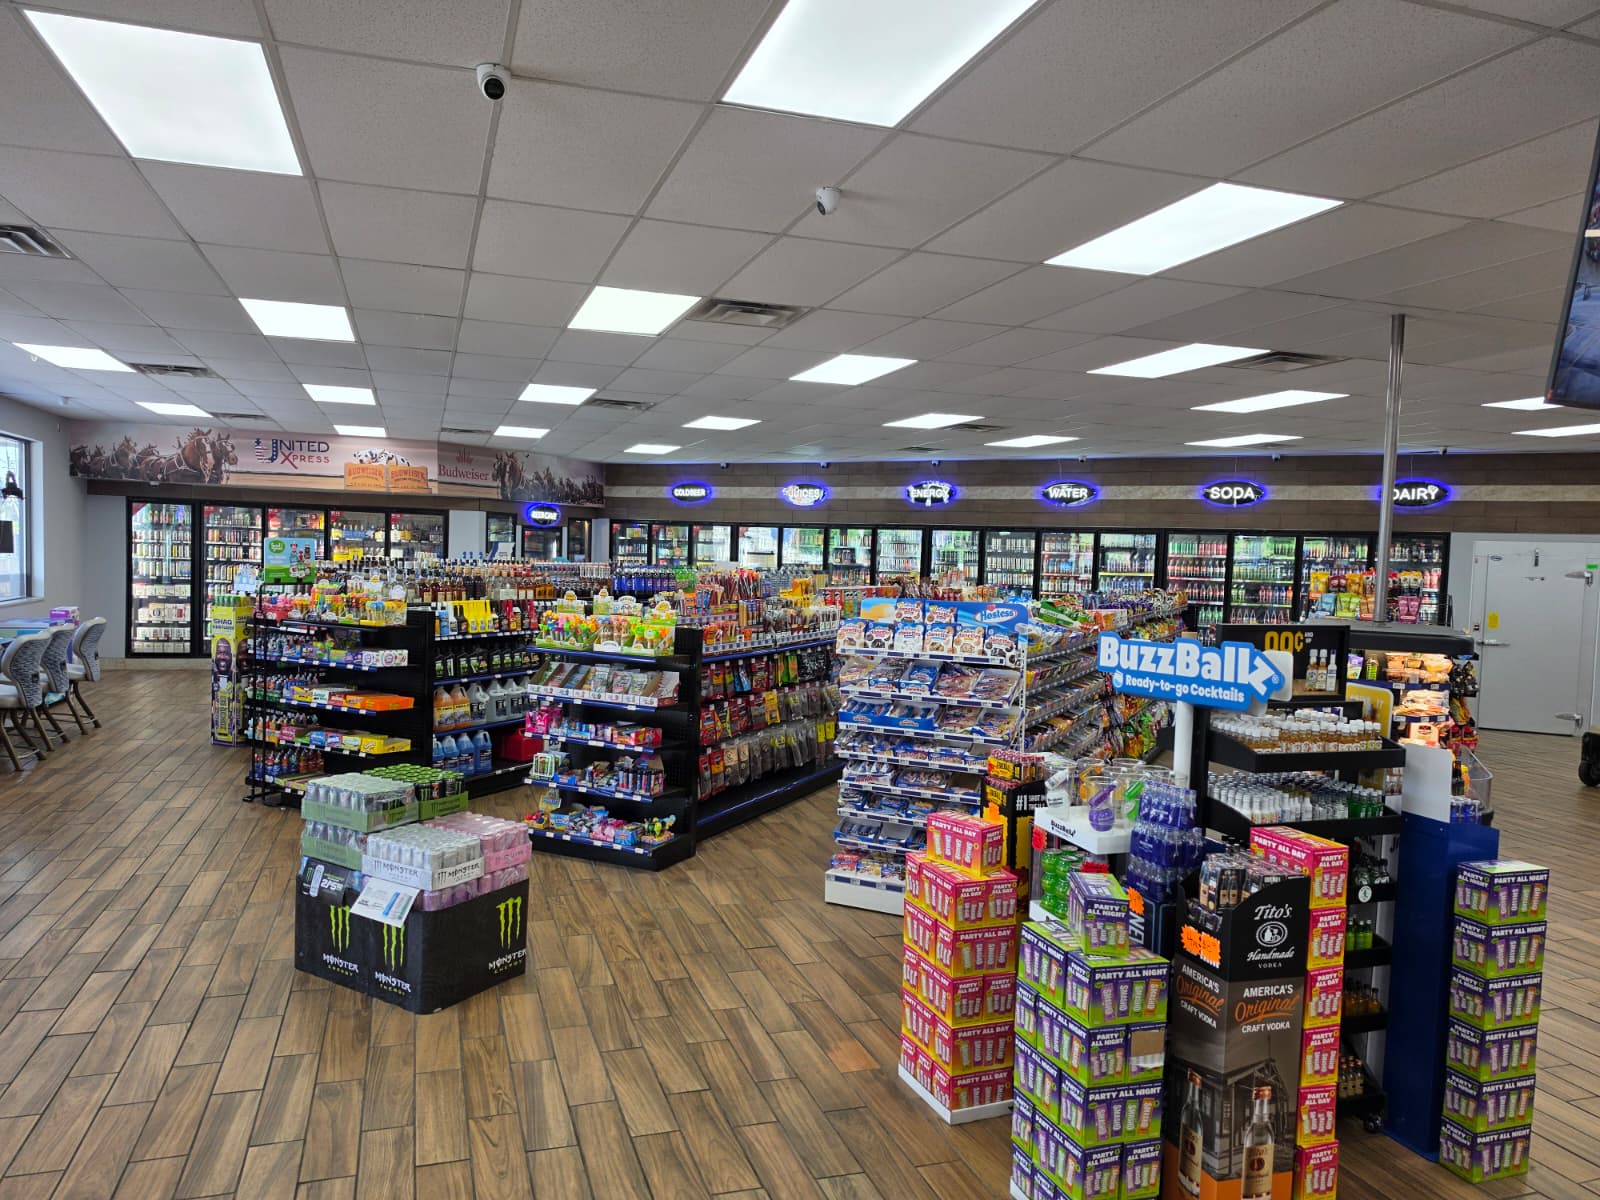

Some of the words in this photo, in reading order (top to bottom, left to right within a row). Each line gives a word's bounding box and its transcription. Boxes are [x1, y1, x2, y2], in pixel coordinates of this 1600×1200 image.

[255, 438, 330, 463] UNITED
[280, 451, 330, 469] XPRESS
[438, 463, 490, 481] Budweiser
[910, 487, 948, 499] ENERGY
[1049, 487, 1087, 499] WATER
[1210, 487, 1255, 499] SODA
[980, 607, 1014, 622] Hostess
[1125, 676, 1190, 697] Ready-to-go
[1190, 683, 1245, 703] Cocktails
[932, 820, 951, 830] PARTY
[953, 825, 963, 834] ALL
[964, 829, 976, 837] DAY
[1254, 836, 1277, 849] PARTY
[1278, 843, 1290, 853] ALL
[1291, 850, 1306, 859] DAY
[384, 863, 418, 876] MONSTER
[449, 863, 480, 877] MONSTER
[1494, 876, 1515, 884] PARTY
[1102, 910, 1126, 918] NIGHT
[1254, 904, 1292, 920] Tito's
[960, 932, 982, 940] PARTY
[1492, 929, 1513, 937] PARTY
[1247, 947, 1295, 962] Handmade
[323, 953, 359, 973] MONSTER
[1095, 971, 1123, 980] PARTY
[1125, 970, 1141, 978] ALL
[1143, 968, 1168, 976] NIGHT
[1181, 964, 1220, 994] AMERICA'S
[375, 972, 411, 992] MONSTER
[1489, 981, 1510, 989] PARTY
[1176, 975, 1225, 1012] Original
[1243, 984, 1294, 998] AMERICA'S
[1180, 1001, 1198, 1017] CRAFT
[1198, 1010, 1217, 1029] VODKA
[1235, 995, 1300, 1022] Original
[1242, 1024, 1265, 1033] CRAFT
[1266, 1021, 1290, 1031] VODKA
[1089, 1090, 1117, 1101] PARTY
[1118, 1090, 1134, 1098] ALL
[1135, 1087, 1161, 1096] NIGHT
